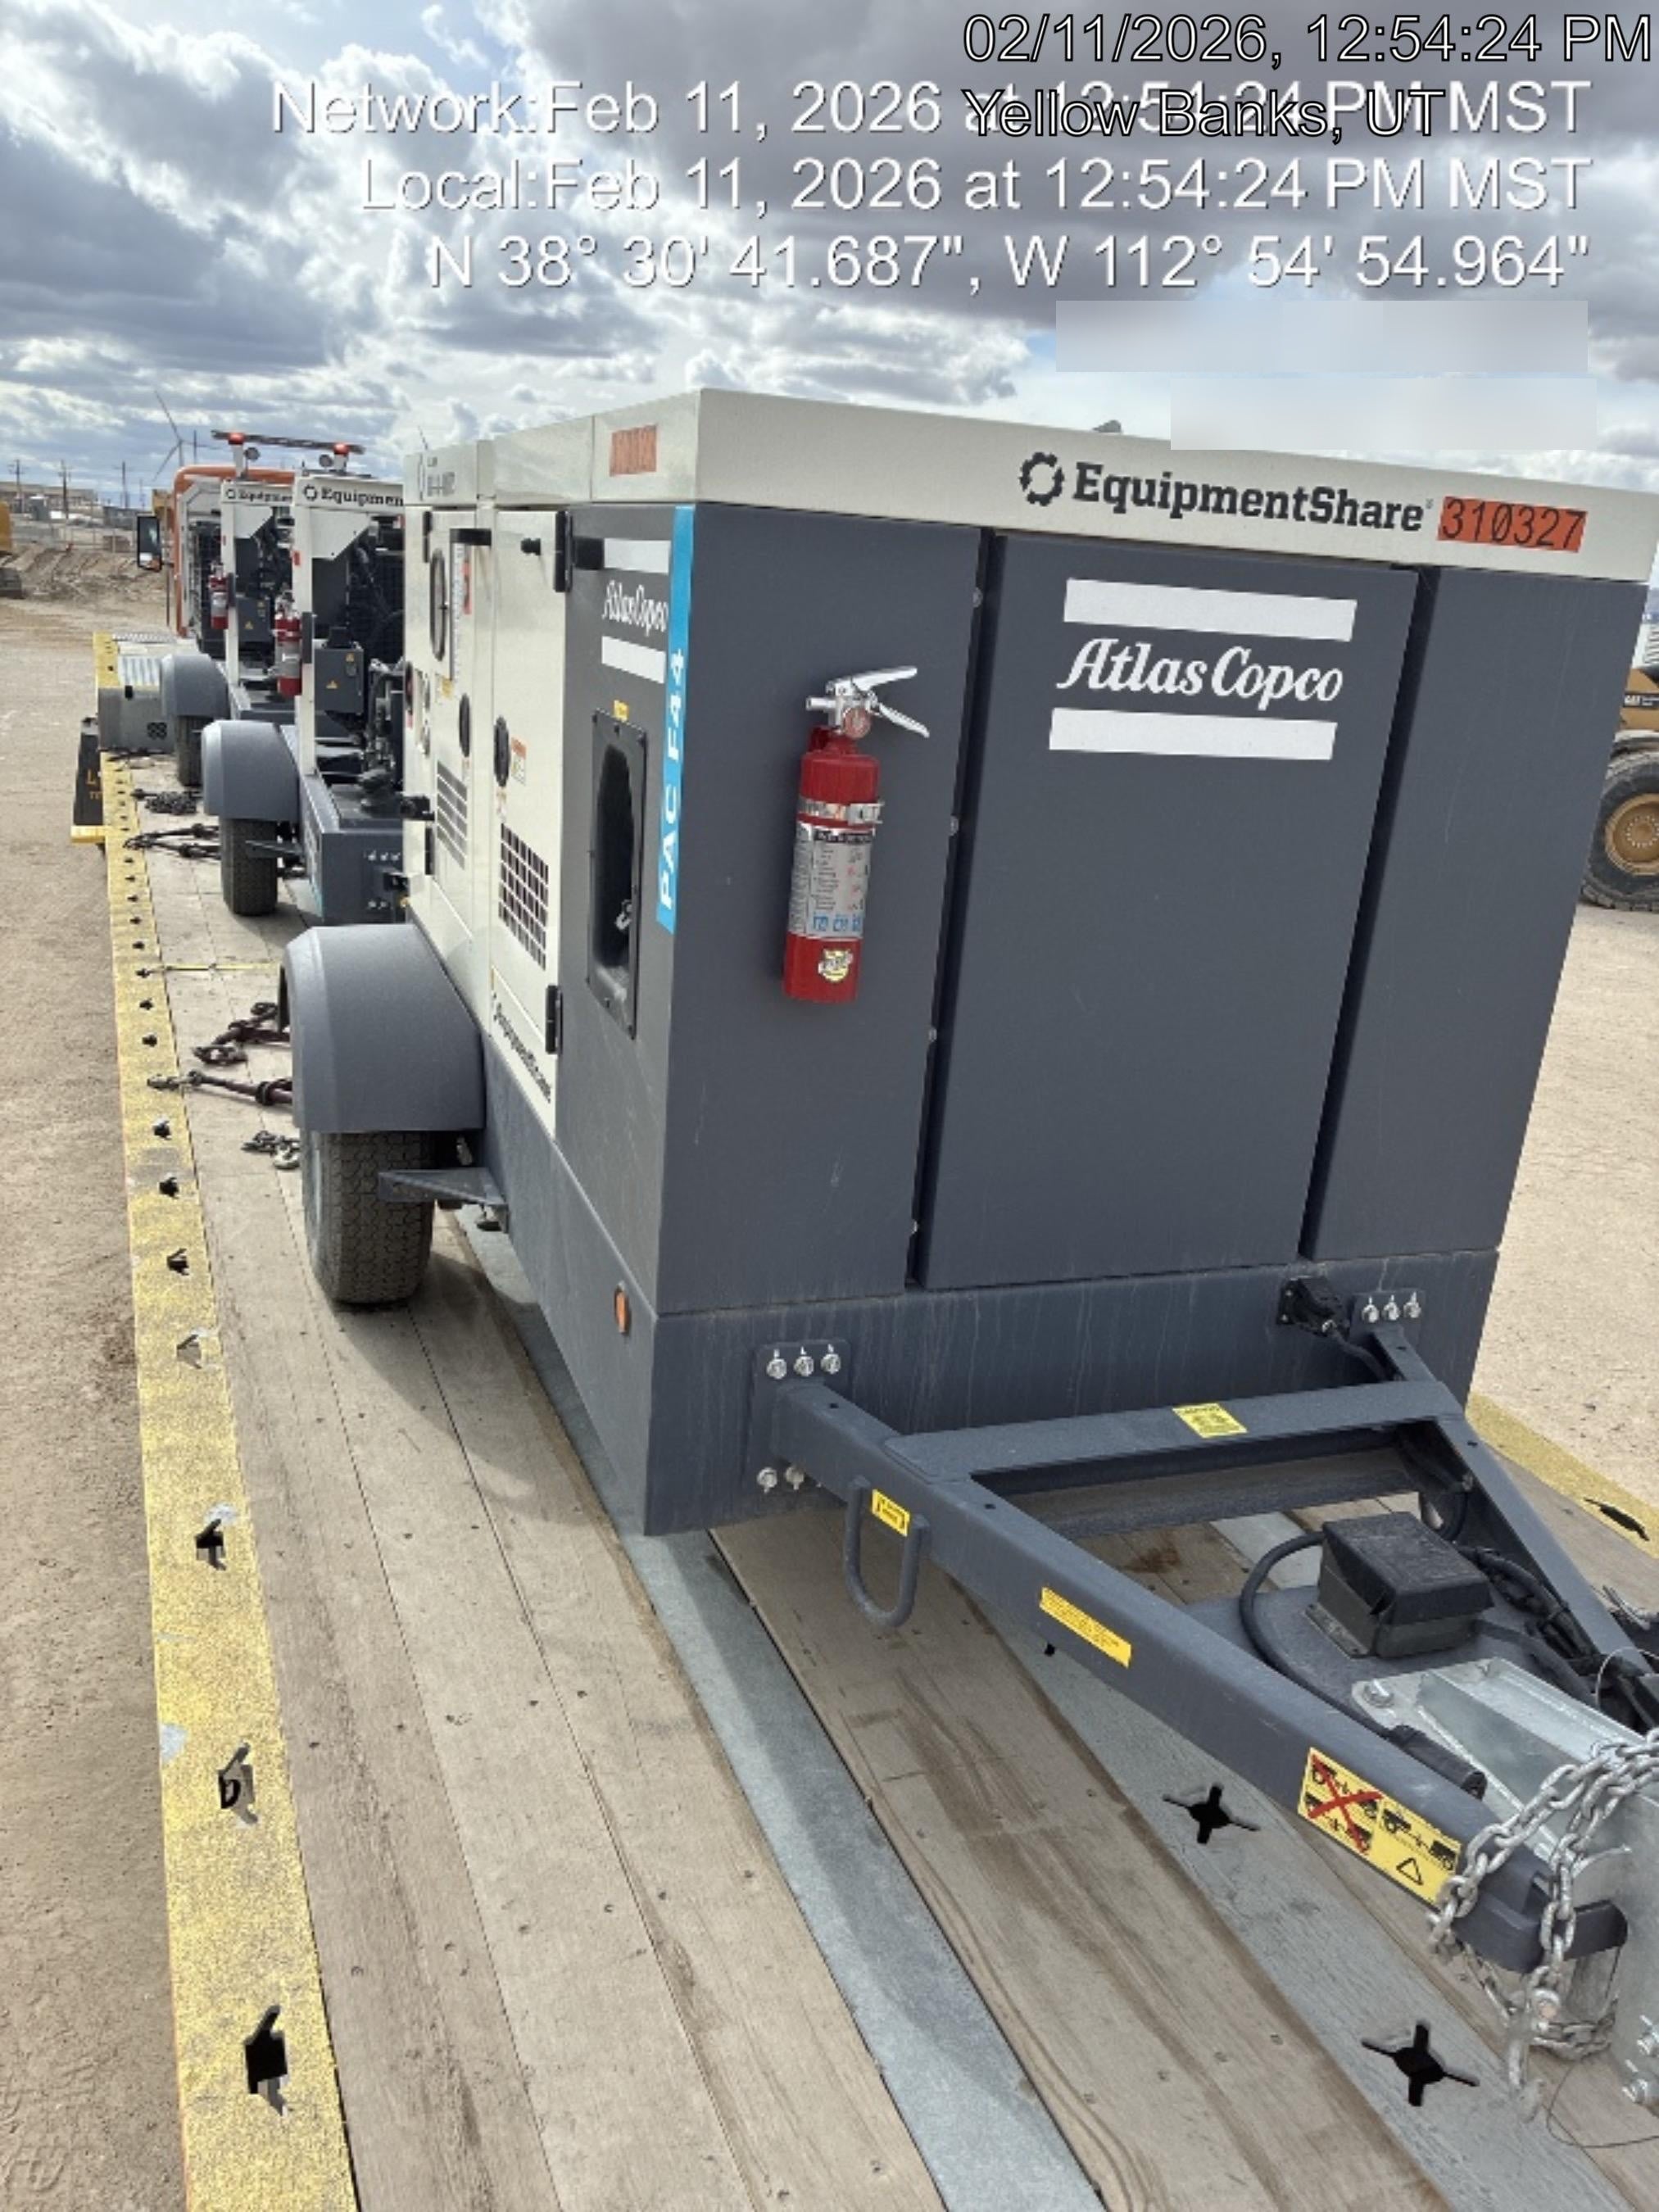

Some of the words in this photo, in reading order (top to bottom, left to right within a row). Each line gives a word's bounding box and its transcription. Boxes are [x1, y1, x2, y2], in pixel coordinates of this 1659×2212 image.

[1443, 498, 1588, 550] 310327
[1056, 637, 1210, 697] Atlas
[1210, 646, 1344, 711] Copco
[660, 784, 677, 910] PAC
